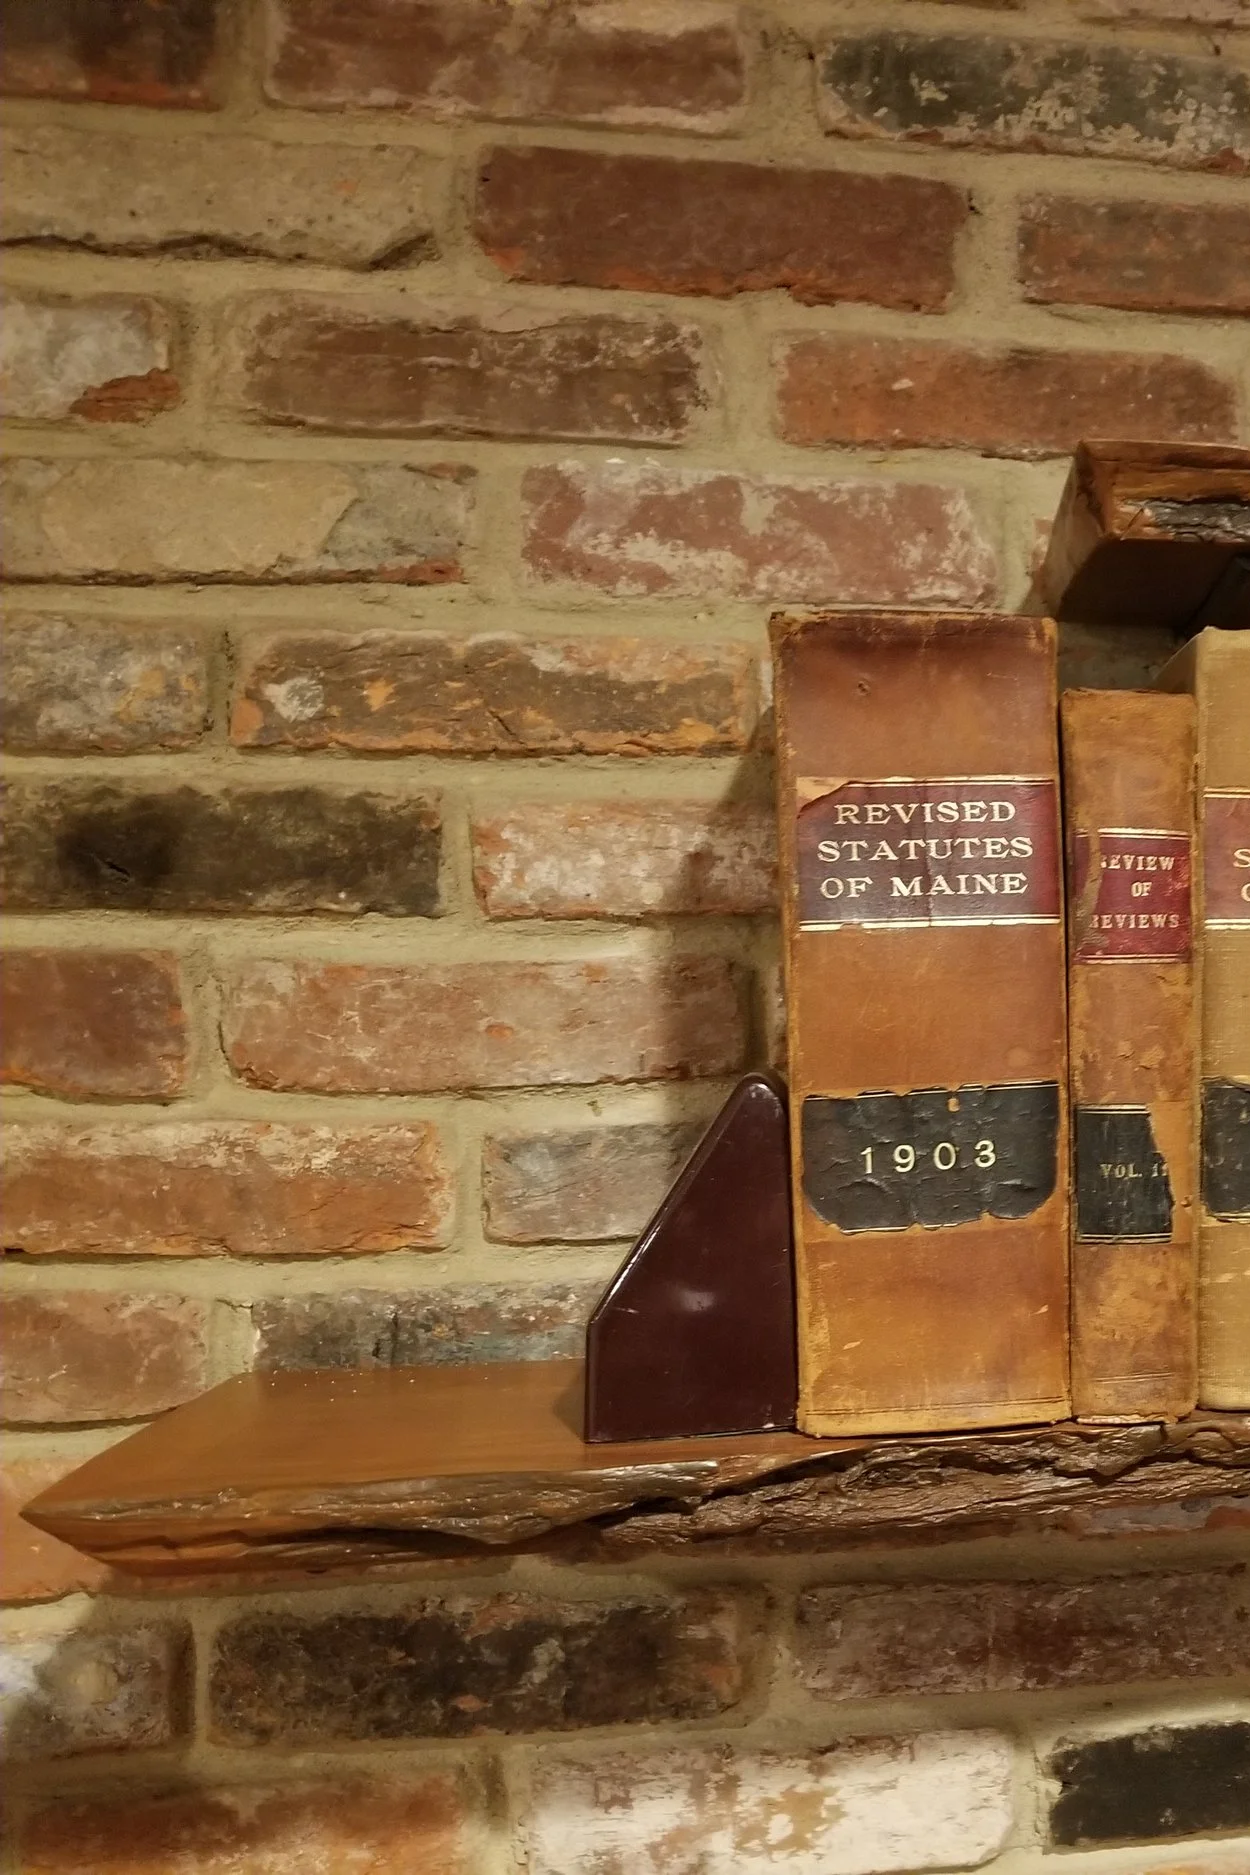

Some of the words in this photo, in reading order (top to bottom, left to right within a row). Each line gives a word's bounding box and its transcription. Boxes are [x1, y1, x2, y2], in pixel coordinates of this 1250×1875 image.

[833, 800, 1016, 825] REVISED
[817, 836, 1034, 862] STATUTES
[819, 876, 874, 899] OF
[889, 871, 1029, 897] MAINE
[1130, 881, 1153, 897] OF
[859, 1139, 997, 1174] 1903
[1100, 1162, 1143, 1179] VOL.
